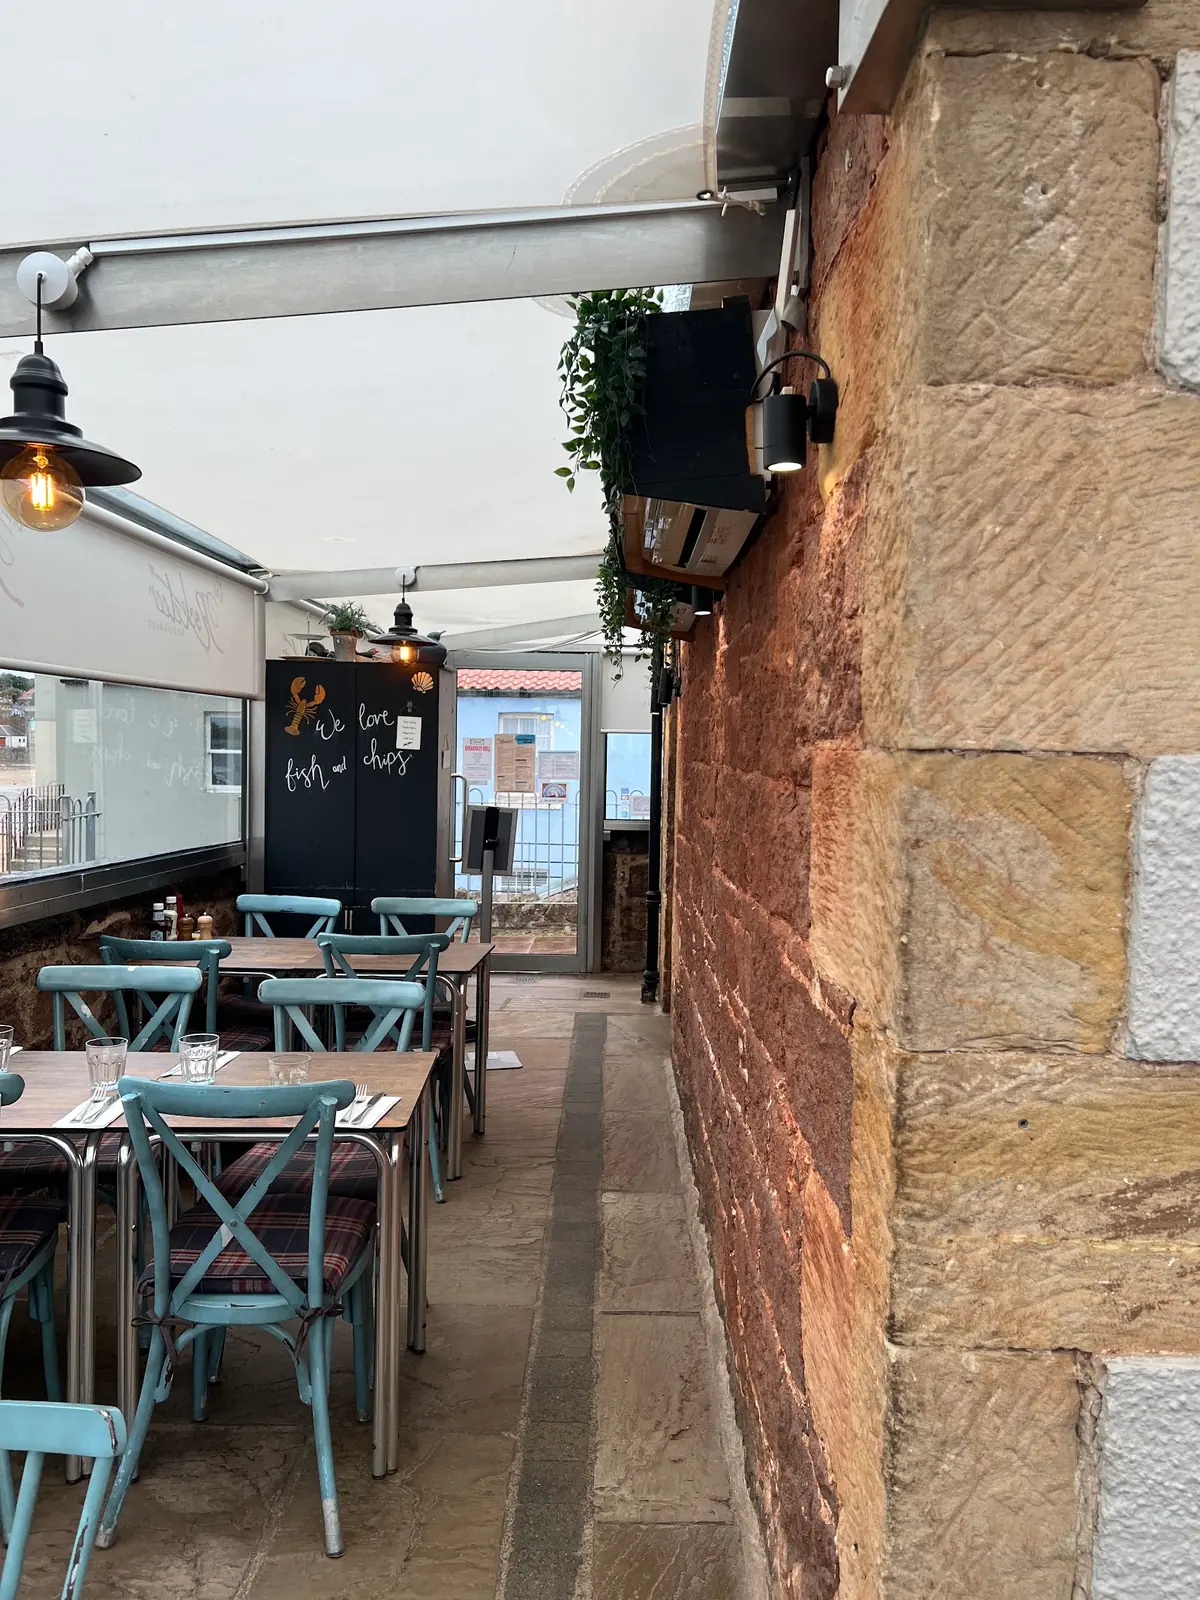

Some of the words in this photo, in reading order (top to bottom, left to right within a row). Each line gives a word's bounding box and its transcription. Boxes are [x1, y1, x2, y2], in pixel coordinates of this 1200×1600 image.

[315, 709, 345, 740] We
[358, 702, 395, 731] love
[285, 754, 330, 792] fish
[332, 756, 347, 774] and
[363, 737, 413, 776] chips
